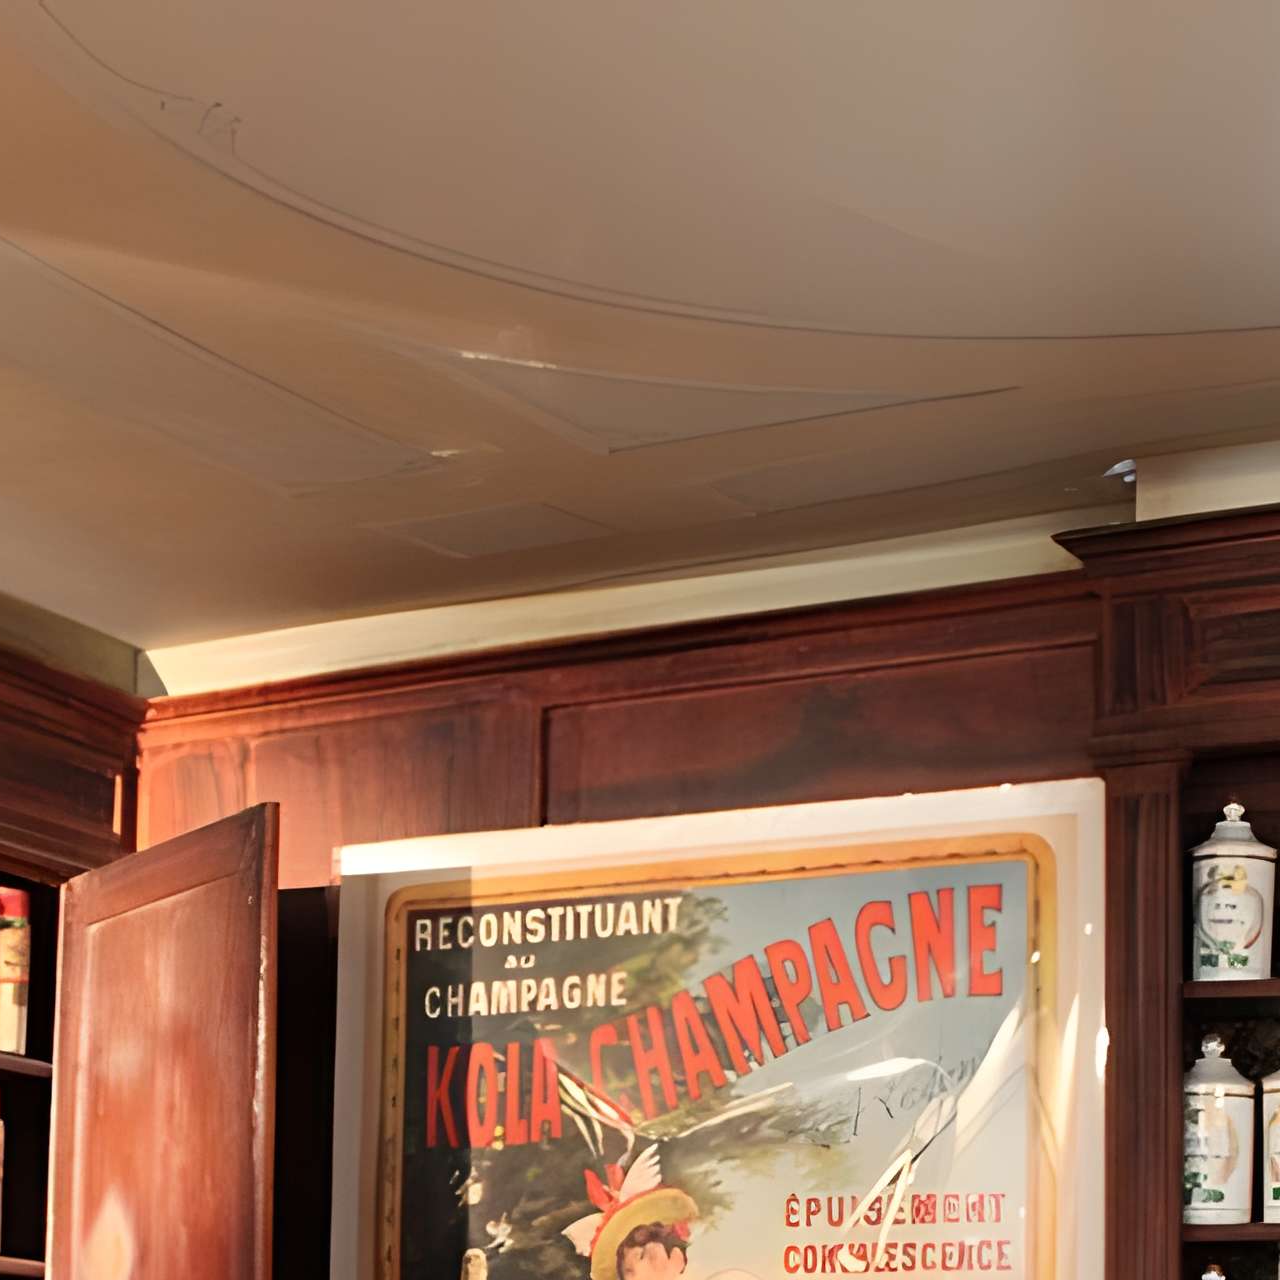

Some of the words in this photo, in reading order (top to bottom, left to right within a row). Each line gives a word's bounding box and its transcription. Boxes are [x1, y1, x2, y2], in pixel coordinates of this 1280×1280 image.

[415, 897, 682, 951] RECONSTITUANT
[425, 972, 628, 1018] CHAMPAGNE
[426, 1036, 562, 1148] KOLA
[588, 883, 1003, 1121] CHAMPAGNE
